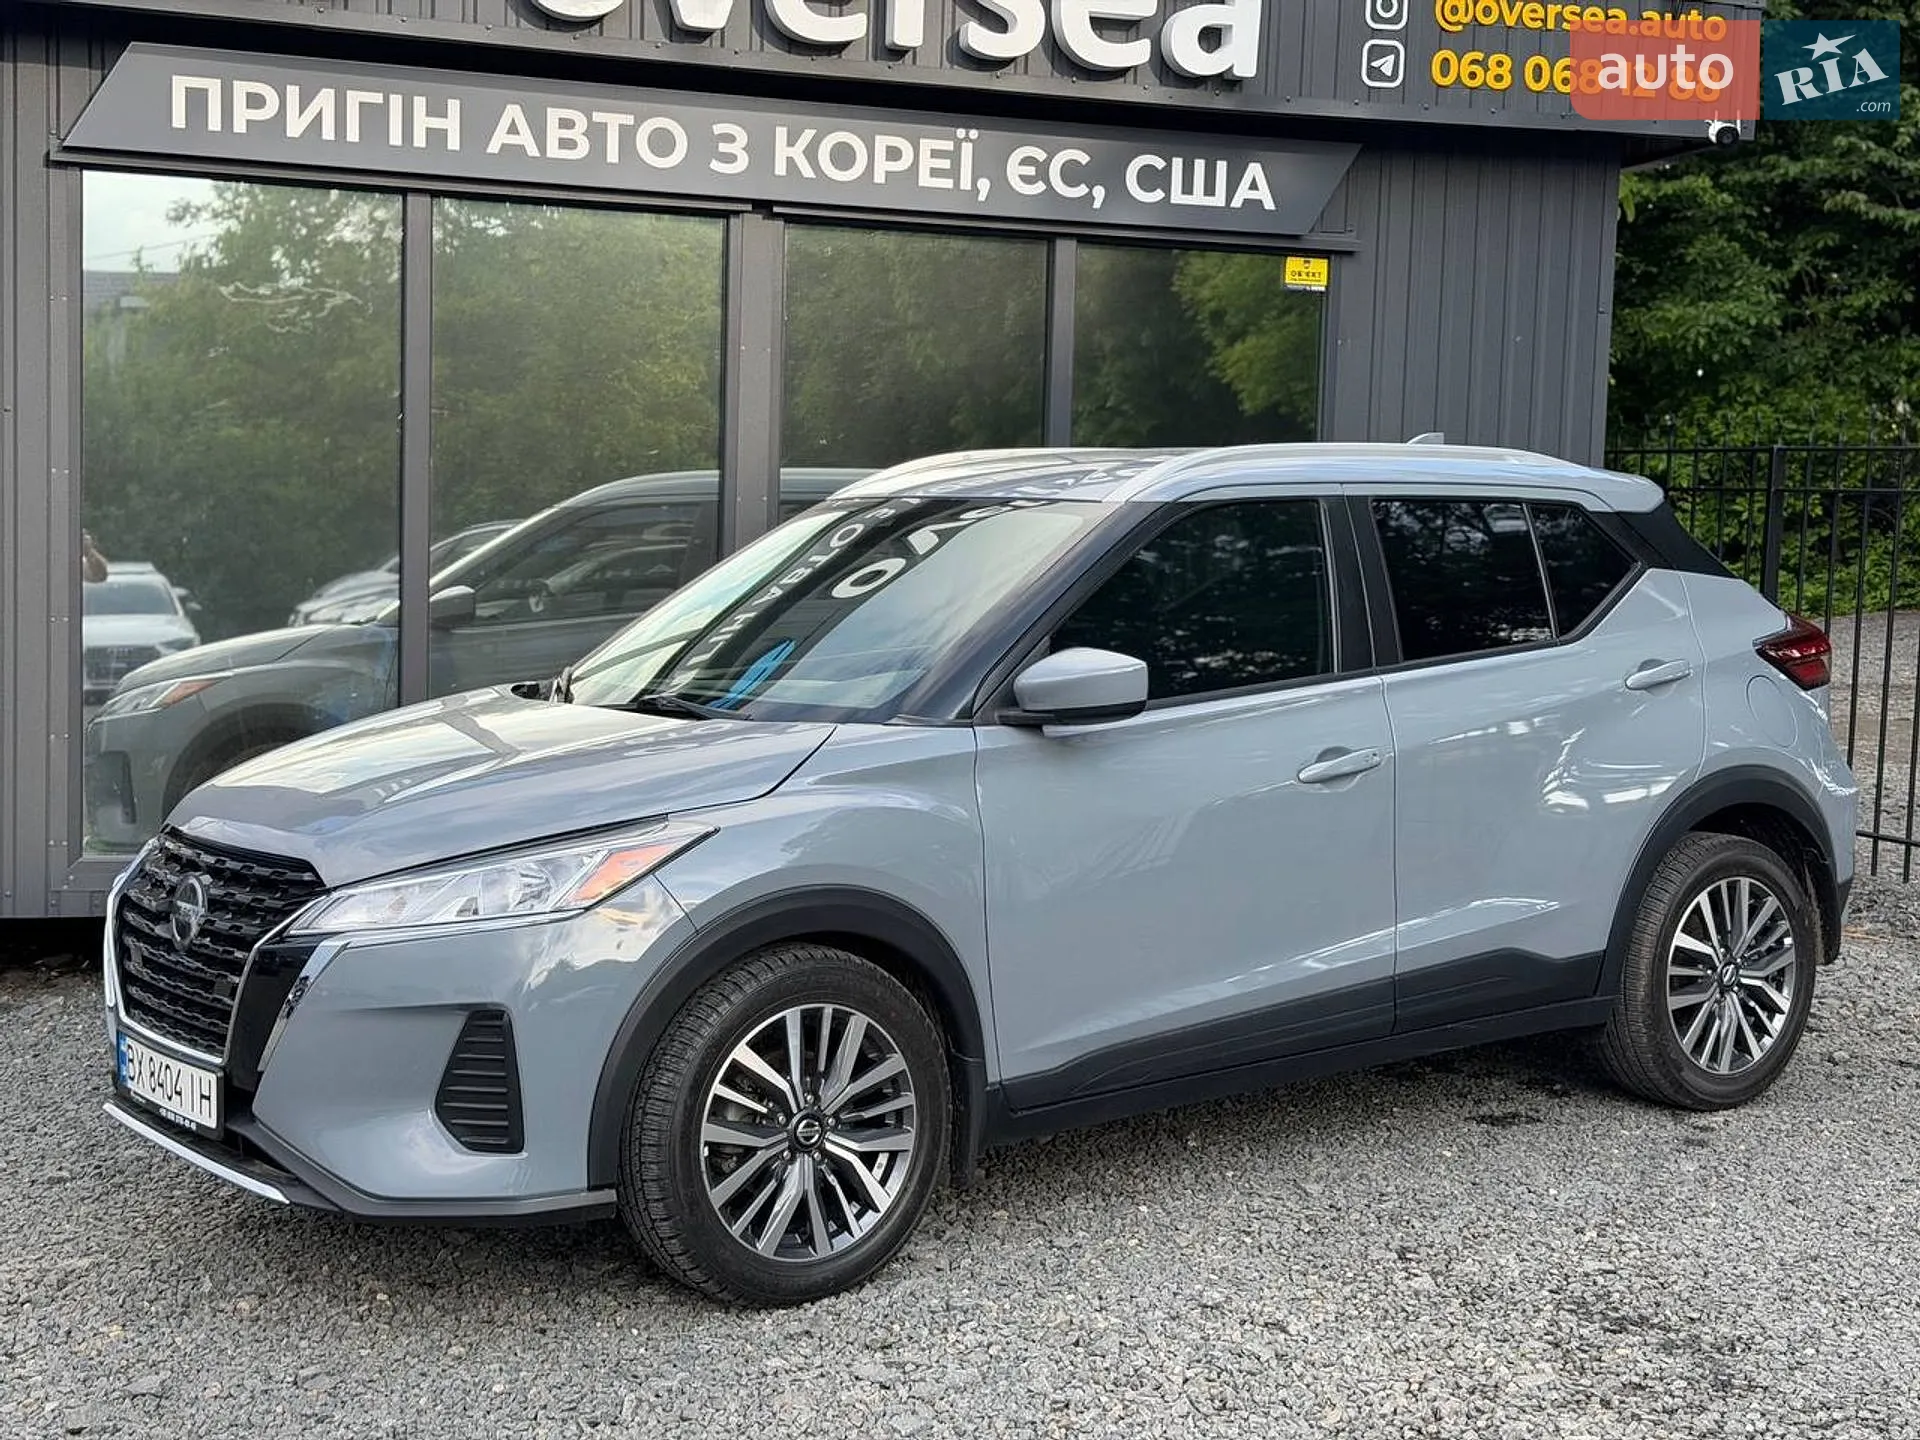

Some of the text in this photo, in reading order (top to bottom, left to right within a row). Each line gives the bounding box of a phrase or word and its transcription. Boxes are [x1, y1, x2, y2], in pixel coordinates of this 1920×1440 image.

[1435, 0, 1727, 42] @oversea.auto
[1431, 50, 1512, 90] 068
[1524, 54, 1605, 95] 068
[171, 75, 1276, 210] ПРИГІН АВТО З КОРЕЇ, ЄС, США
[148, 1055, 183, 1109] 8404
